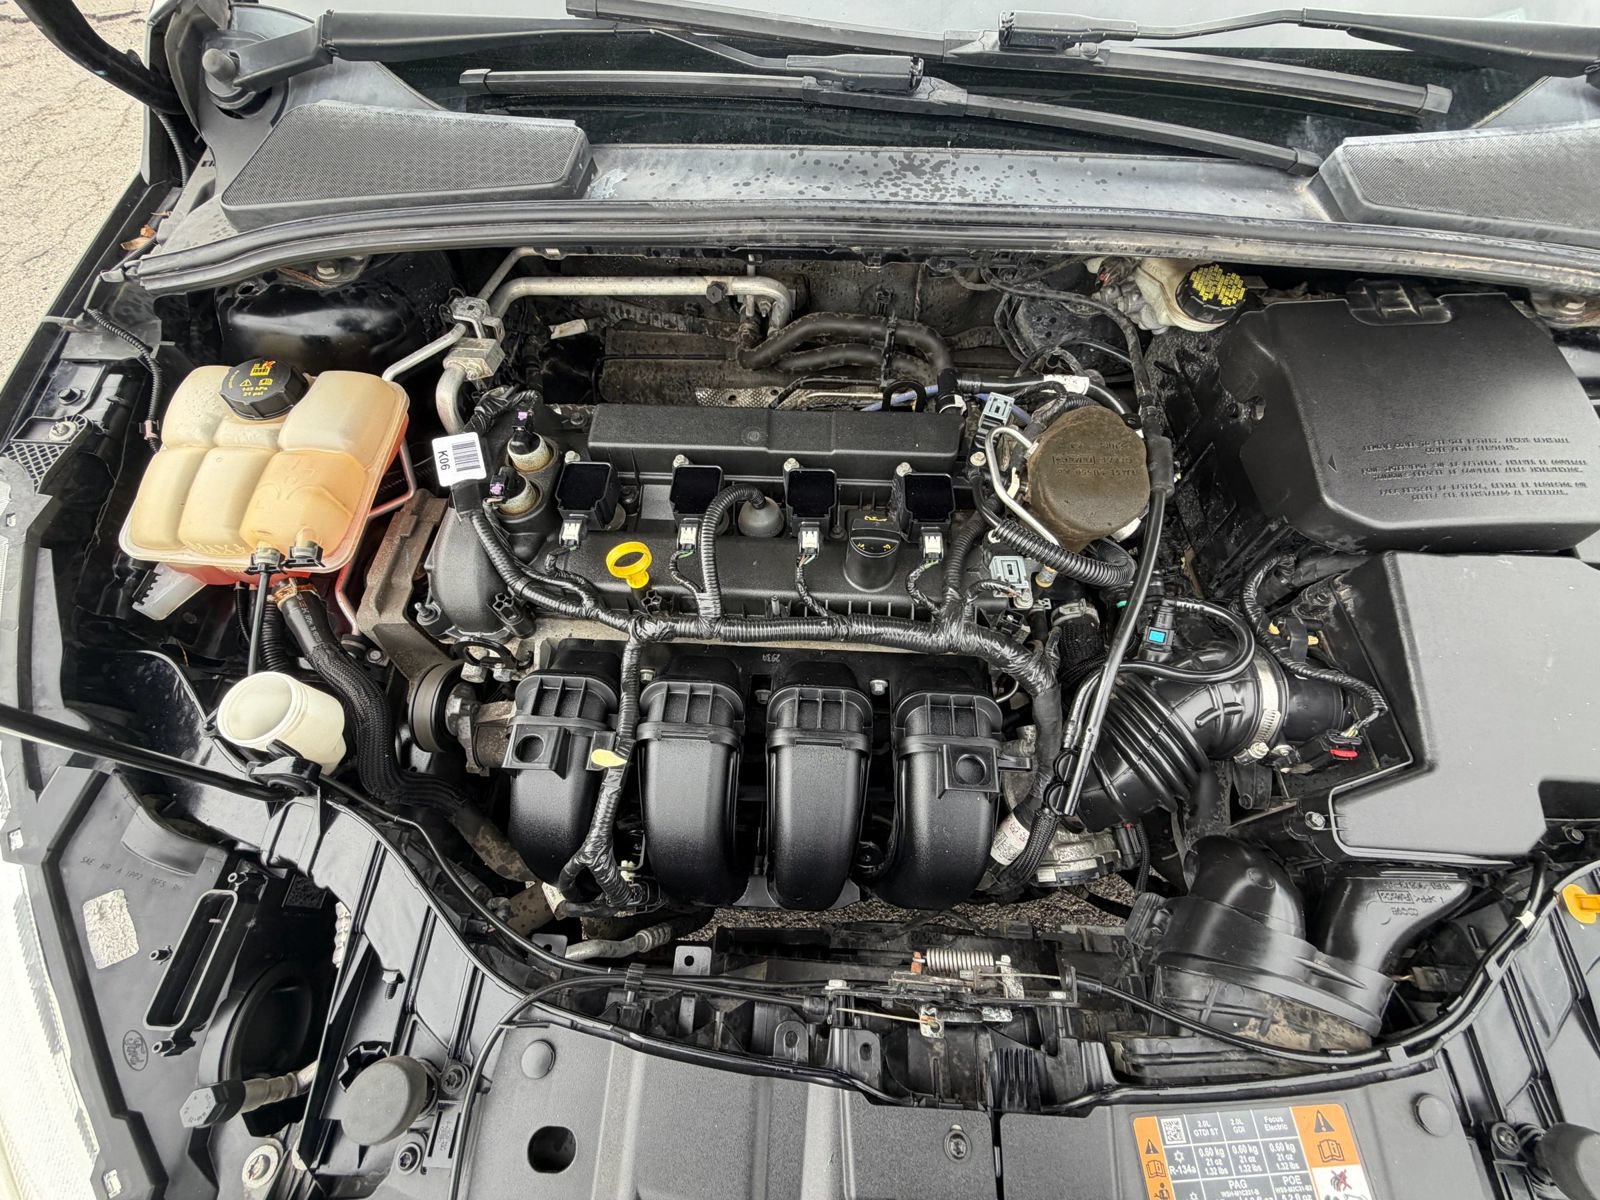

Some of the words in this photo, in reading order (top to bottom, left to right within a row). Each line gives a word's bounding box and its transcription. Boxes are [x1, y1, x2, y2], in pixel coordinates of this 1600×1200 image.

[438, 450, 451, 470] K06
[1197, 1120, 1211, 1128] 2.0L
[1230, 1118, 1244, 1126] 2.0L
[1264, 1116, 1284, 1124] Focus
[1264, 1123, 1288, 1132] Electric
[1198, 1147, 1215, 1158] 0.60
[1215, 1146, 1225, 1158] kg
[1231, 1145, 1247, 1155] 0.60
[1247, 1144, 1258, 1155] kg
[1268, 1143, 1285, 1153] 0.60
[1285, 1141, 1296, 1153] kg
[1239, 1155, 1247, 1164] 21
[1276, 1153, 1284, 1161] 21
[1284, 1153, 1294, 1161] oz
[1205, 1159, 1213, 1167] 21
[1238, 1164, 1252, 1173] 1.32
[1252, 1163, 1262, 1172] lbs
[1275, 1162, 1289, 1171] 1.32
[1289, 1162, 1300, 1170] lbs
[1168, 1164, 1197, 1176] R-134a
[1204, 1167, 1218, 1176] 1.32
[1218, 1166, 1229, 1175] lbs
[1228, 1179, 1248, 1189] PAG
[1282, 1175, 1303, 1185] POE
